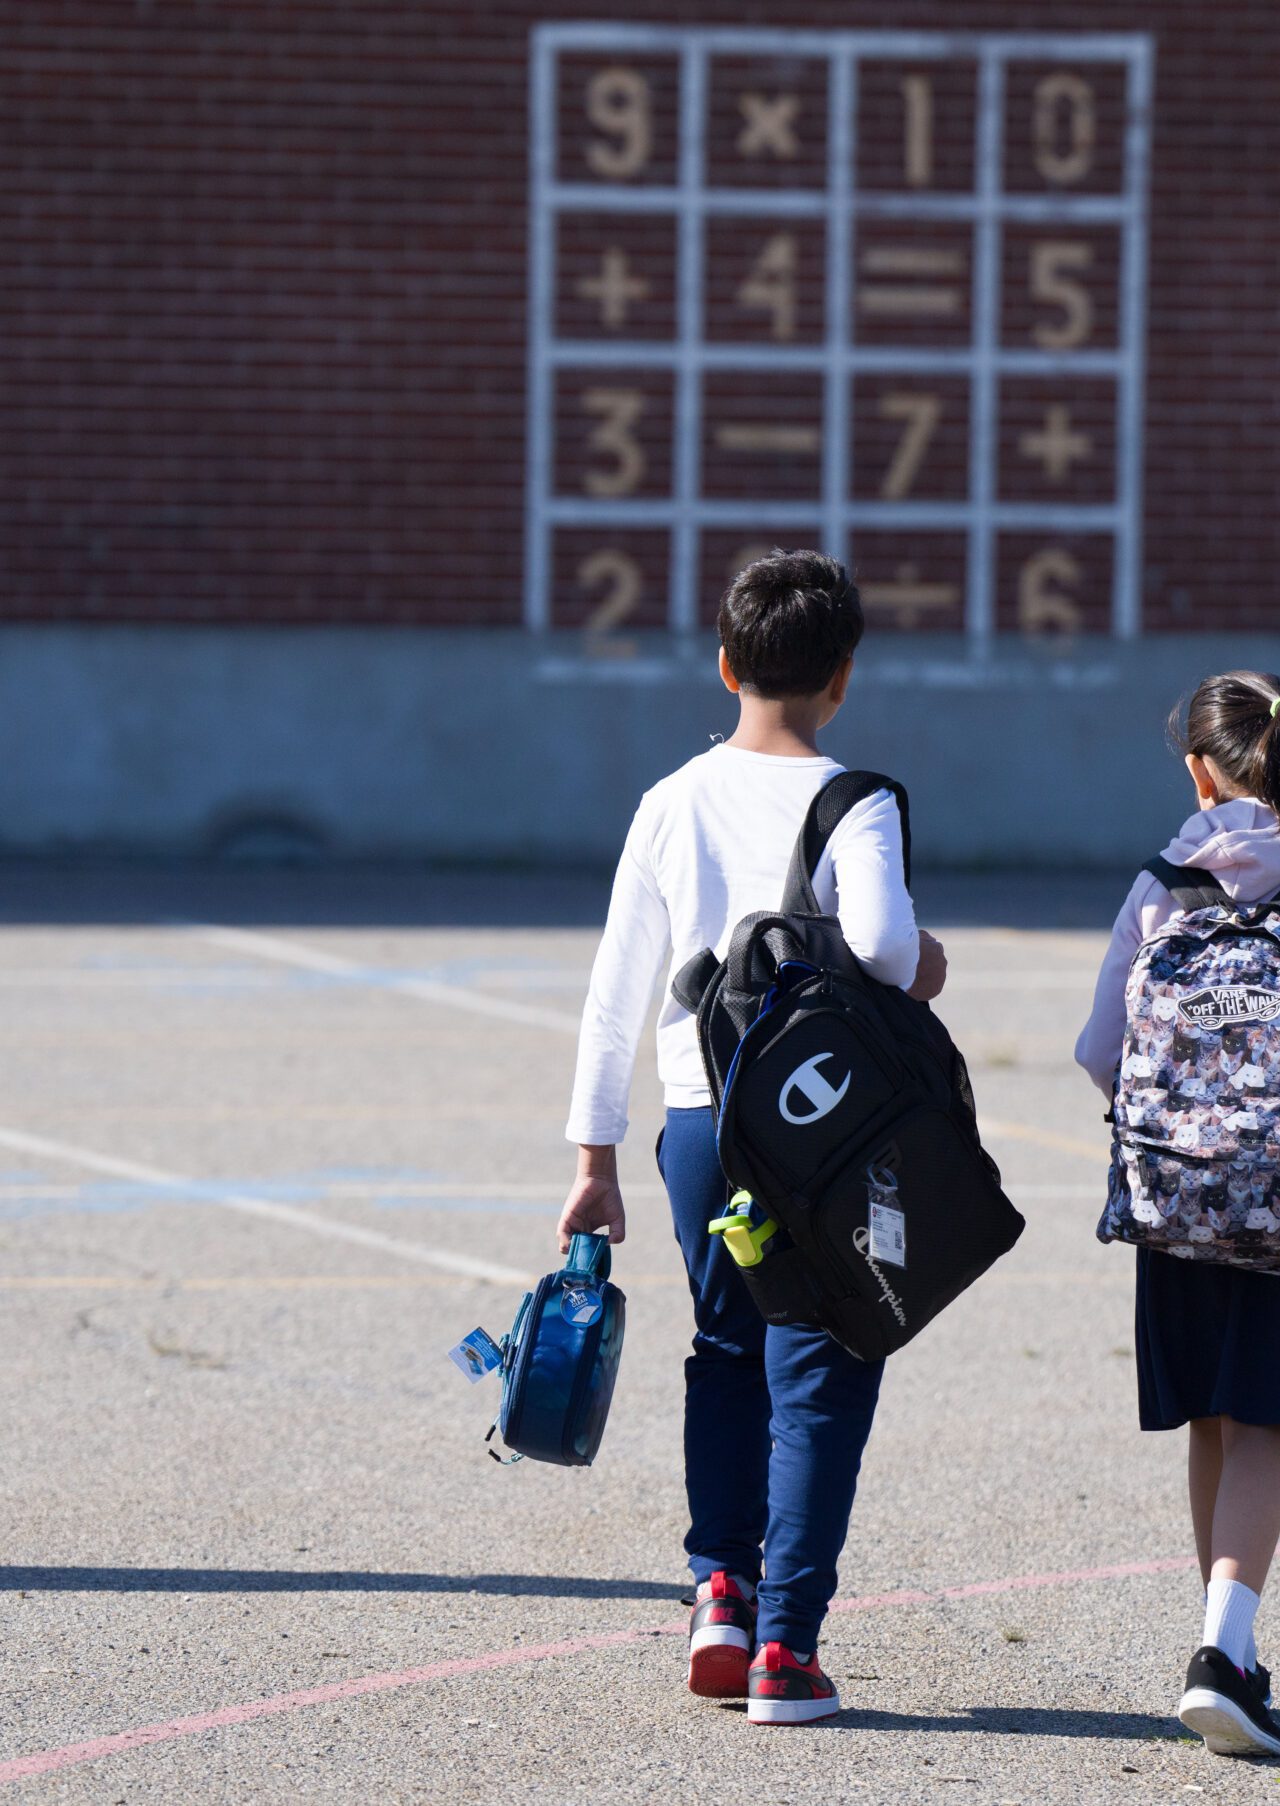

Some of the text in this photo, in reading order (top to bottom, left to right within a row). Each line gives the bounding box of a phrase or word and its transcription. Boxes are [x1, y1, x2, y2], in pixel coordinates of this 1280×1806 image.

[585, 67, 653, 179] 9
[904, 73, 933, 187] 1
[1031, 73, 1095, 183] 0
[736, 233, 797, 341] 4
[1029, 240, 1094, 351] 5
[584, 387, 649, 497] 3
[878, 393, 942, 500] 7
[576, 548, 643, 660] 2
[1016, 549, 1084, 657] 6
[1210, 989, 1248, 1003] VANS
[1216, 999, 1246, 1015] THE
[756, 1678, 789, 1695] NIKE
